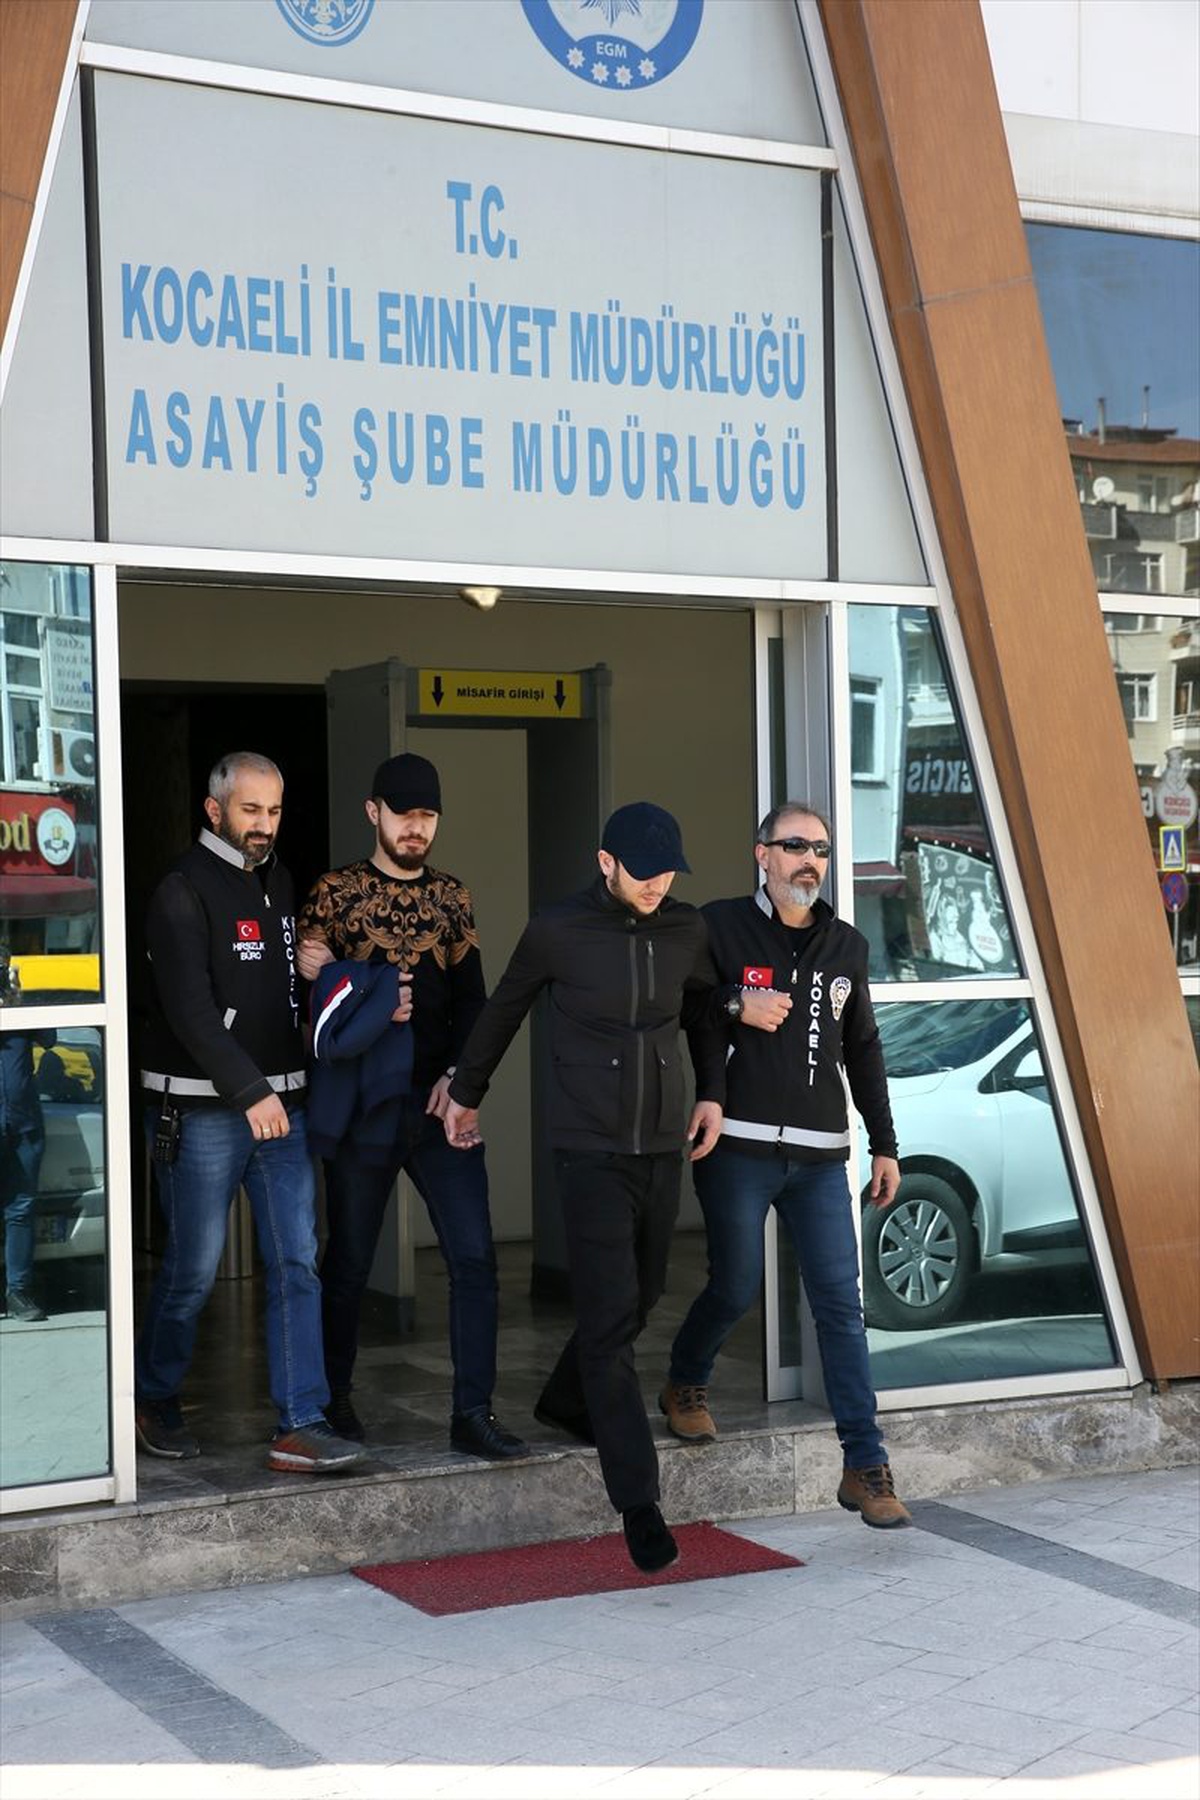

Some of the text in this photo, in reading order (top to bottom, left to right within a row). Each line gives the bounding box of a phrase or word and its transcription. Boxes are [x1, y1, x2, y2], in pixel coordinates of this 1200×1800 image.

[596, 41, 627, 58] EGM
[448, 181, 518, 258] T.C.
[122, 263, 807, 401] KOCAELİ İL EMNİYET MÜDÜRLÜĞÜ
[126, 383, 806, 510] ASAYİŞ ŞUBE MÜDÜRLÜĞÜ
[456, 686, 545, 702] MİSAFİR GİRİŞİ
[240, 950, 261, 961] BÜRO
[807, 970, 824, 1087] KOCAELI
